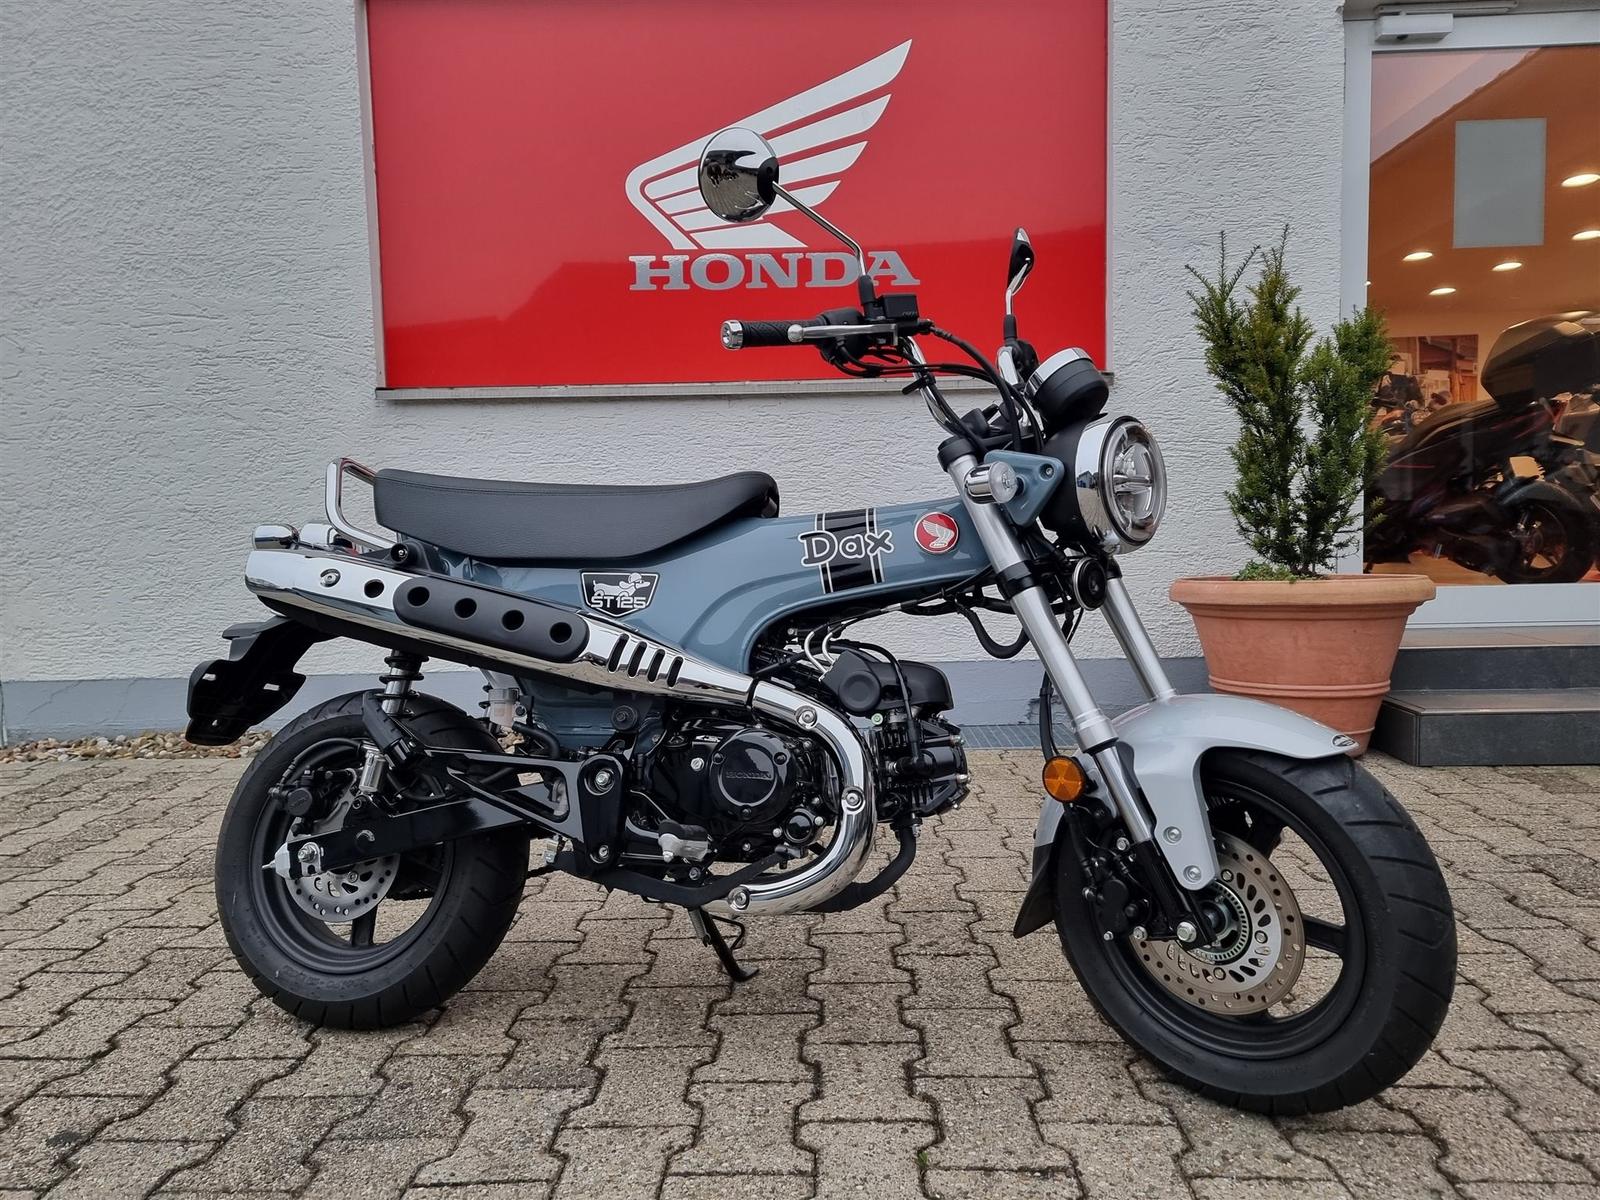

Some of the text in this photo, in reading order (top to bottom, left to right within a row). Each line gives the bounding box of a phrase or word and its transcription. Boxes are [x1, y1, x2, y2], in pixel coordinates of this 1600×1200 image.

[629, 251, 920, 290] HONDA
[798, 529, 895, 567] Dax
[590, 595, 647, 609] ST125
